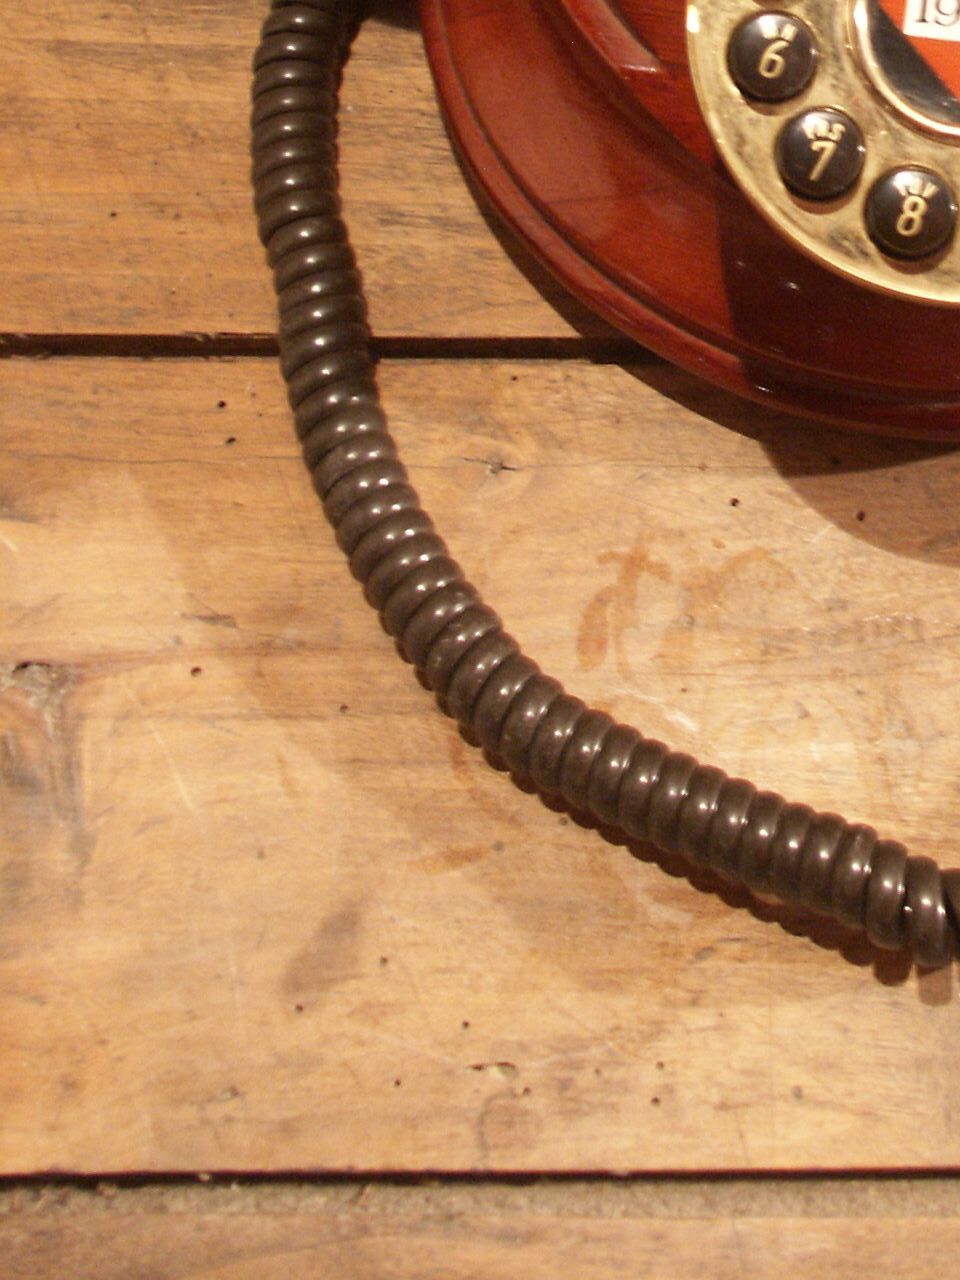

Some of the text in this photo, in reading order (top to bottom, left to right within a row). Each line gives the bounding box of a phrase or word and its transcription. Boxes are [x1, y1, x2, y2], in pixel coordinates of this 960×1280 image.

[758, 39, 790, 79] 6
[809, 139, 839, 182] 7
[895, 194, 929, 238] 8
